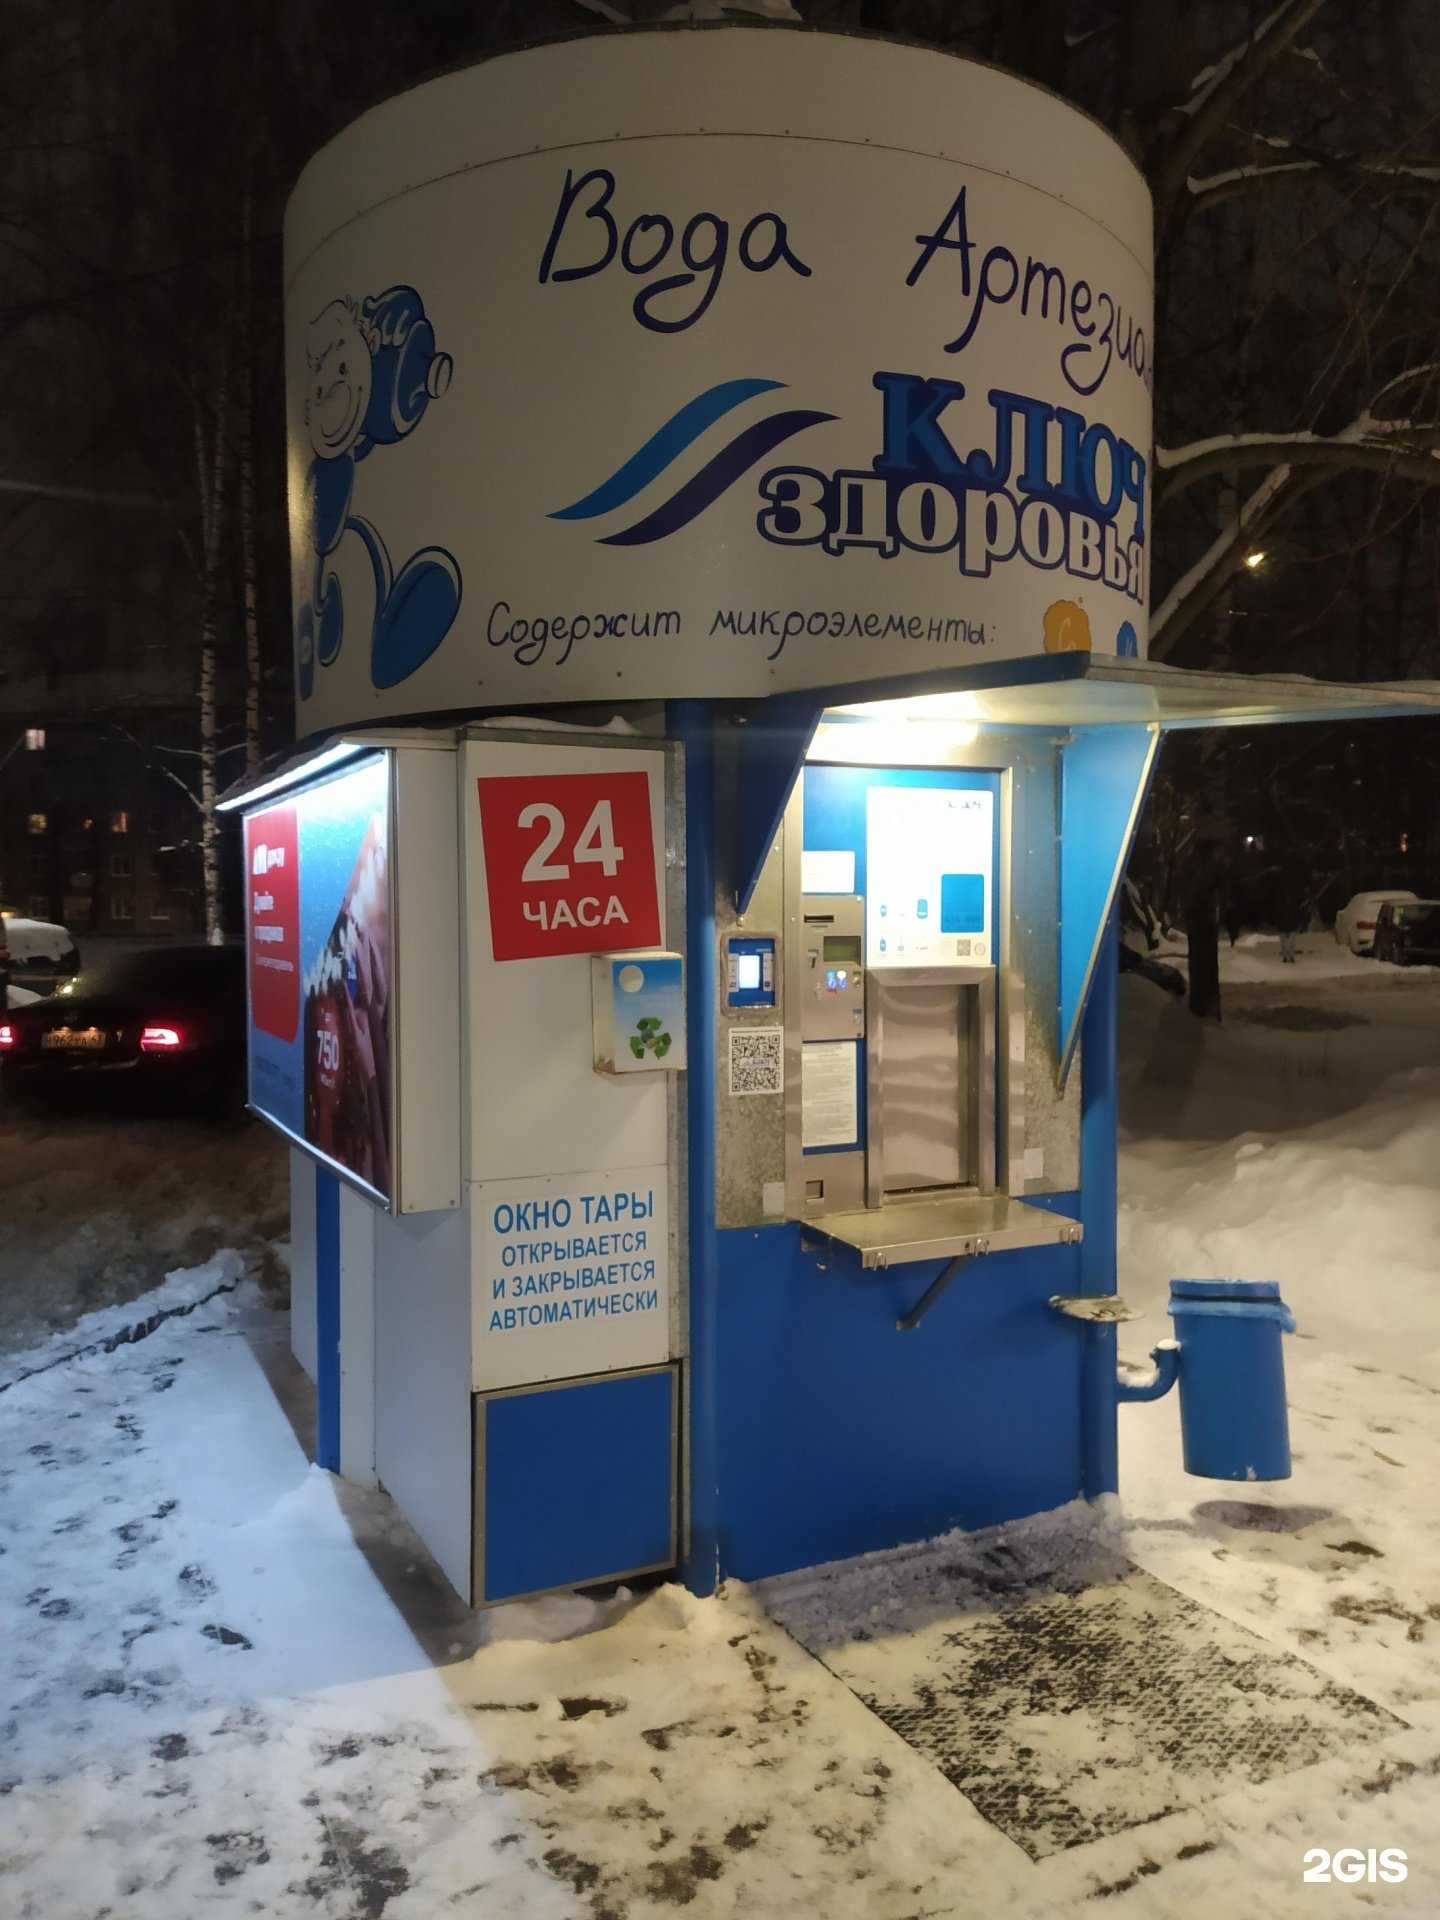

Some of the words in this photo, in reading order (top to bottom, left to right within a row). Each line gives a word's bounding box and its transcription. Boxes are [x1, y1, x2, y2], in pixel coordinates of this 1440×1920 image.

[538, 168, 812, 333] Вода
[486, 601, 681, 665] Содержит
[709, 608, 996, 660] микроэлементы:
[516, 799, 624, 883] 24
[522, 895, 629, 931] ЧАСА
[316, 1029, 340, 1071] 750
[493, 1198, 572, 1235] ОКНО
[579, 1190, 653, 1225] ТАРЫ
[501, 1230, 647, 1267] ОТКРЫВАЕТСЯ
[492, 1278, 506, 1300] И
[511, 1259, 656, 1298] ЗАКРЫВАЕТСЯ
[489, 1289, 659, 1332] АВТОМАТИЧЕСКИ
